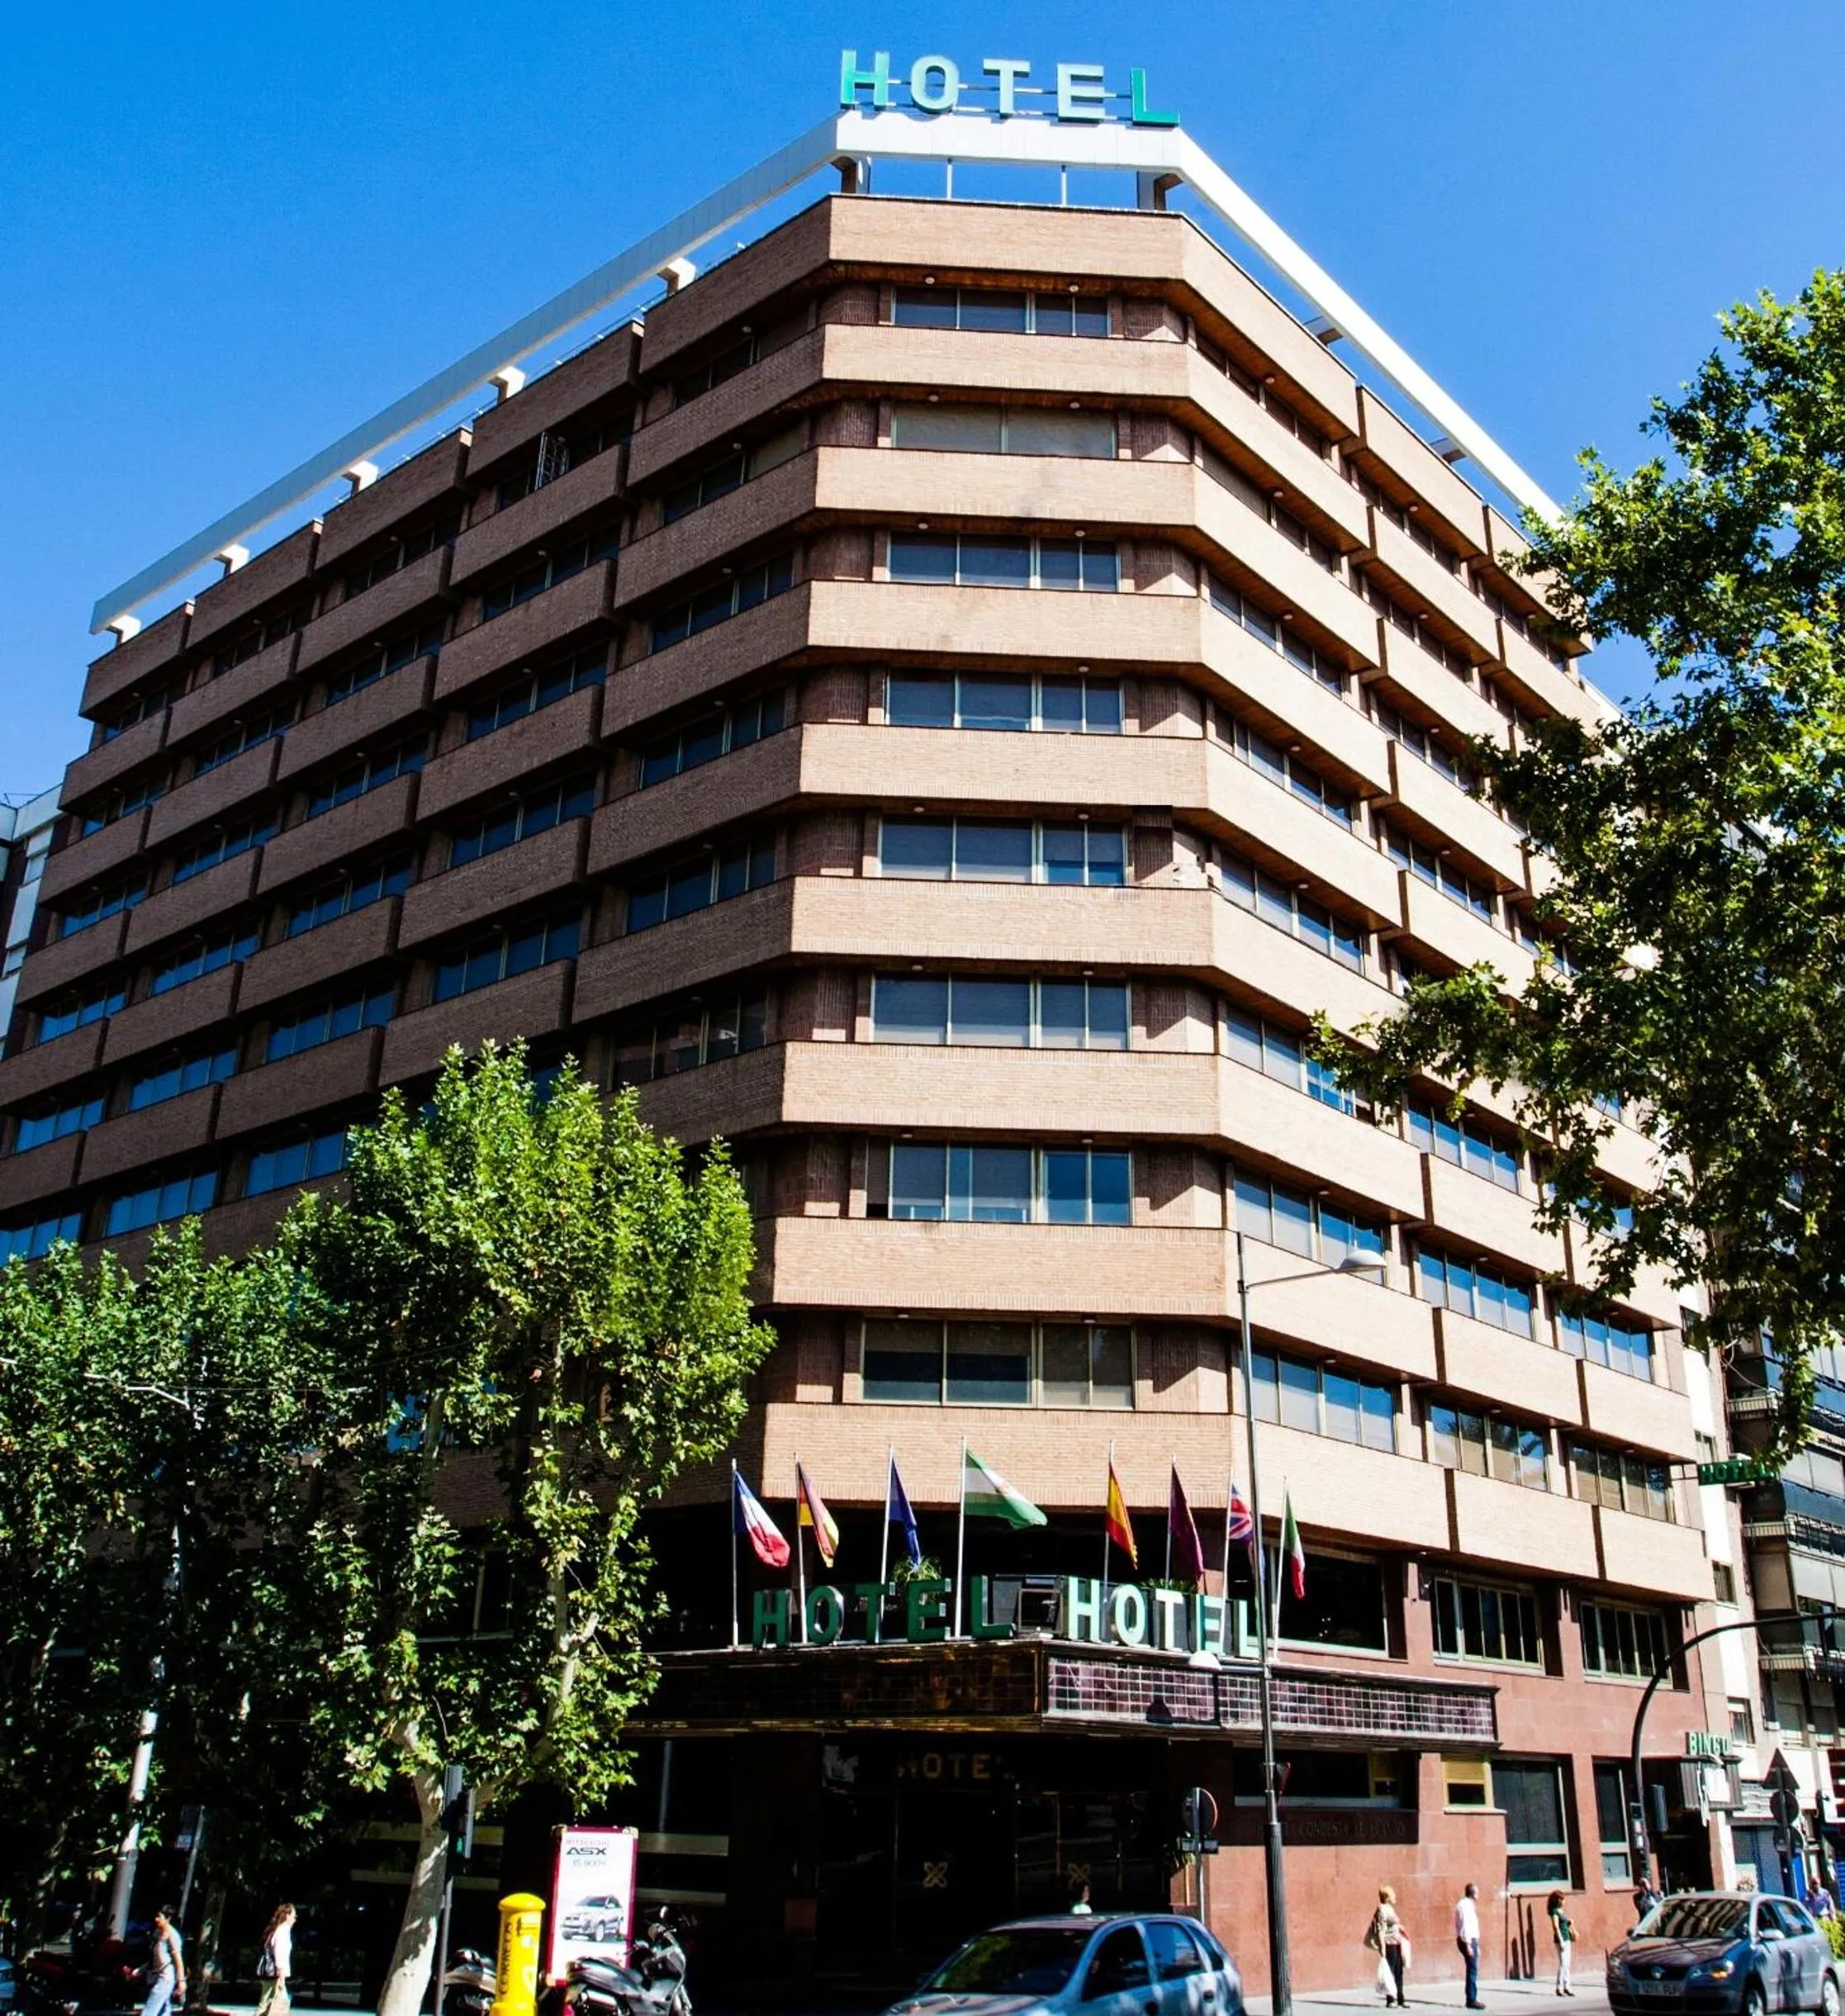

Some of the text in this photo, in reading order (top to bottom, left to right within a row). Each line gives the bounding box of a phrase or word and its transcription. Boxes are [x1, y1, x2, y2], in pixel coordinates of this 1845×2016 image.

[840, 49, 1180, 127] HOTEL
[752, 1573, 1016, 1648] HOTEL
[1067, 1576, 1261, 1660] HOTEL
[566, 1847, 607, 1856] ASX
